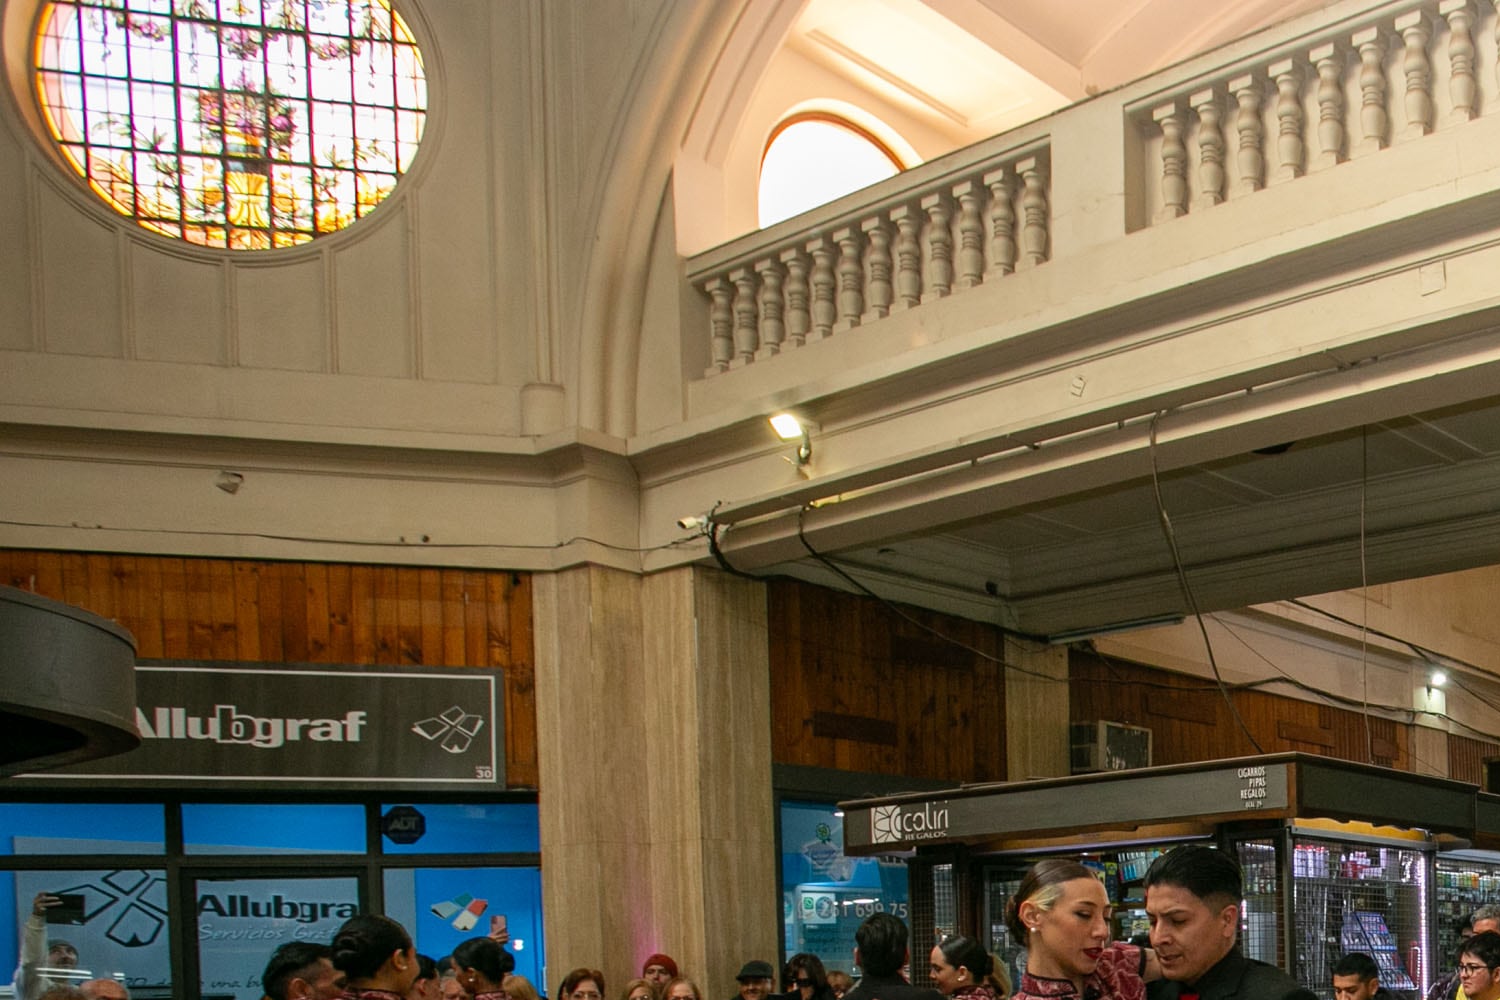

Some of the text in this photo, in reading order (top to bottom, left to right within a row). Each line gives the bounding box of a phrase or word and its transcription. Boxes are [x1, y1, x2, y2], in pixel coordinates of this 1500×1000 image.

[475, 769, 492, 779] 30
[1240, 788, 1266, 799] REGALOS
[905, 830, 947, 840] REGALOS
[199, 923, 286, 941] Servicios
